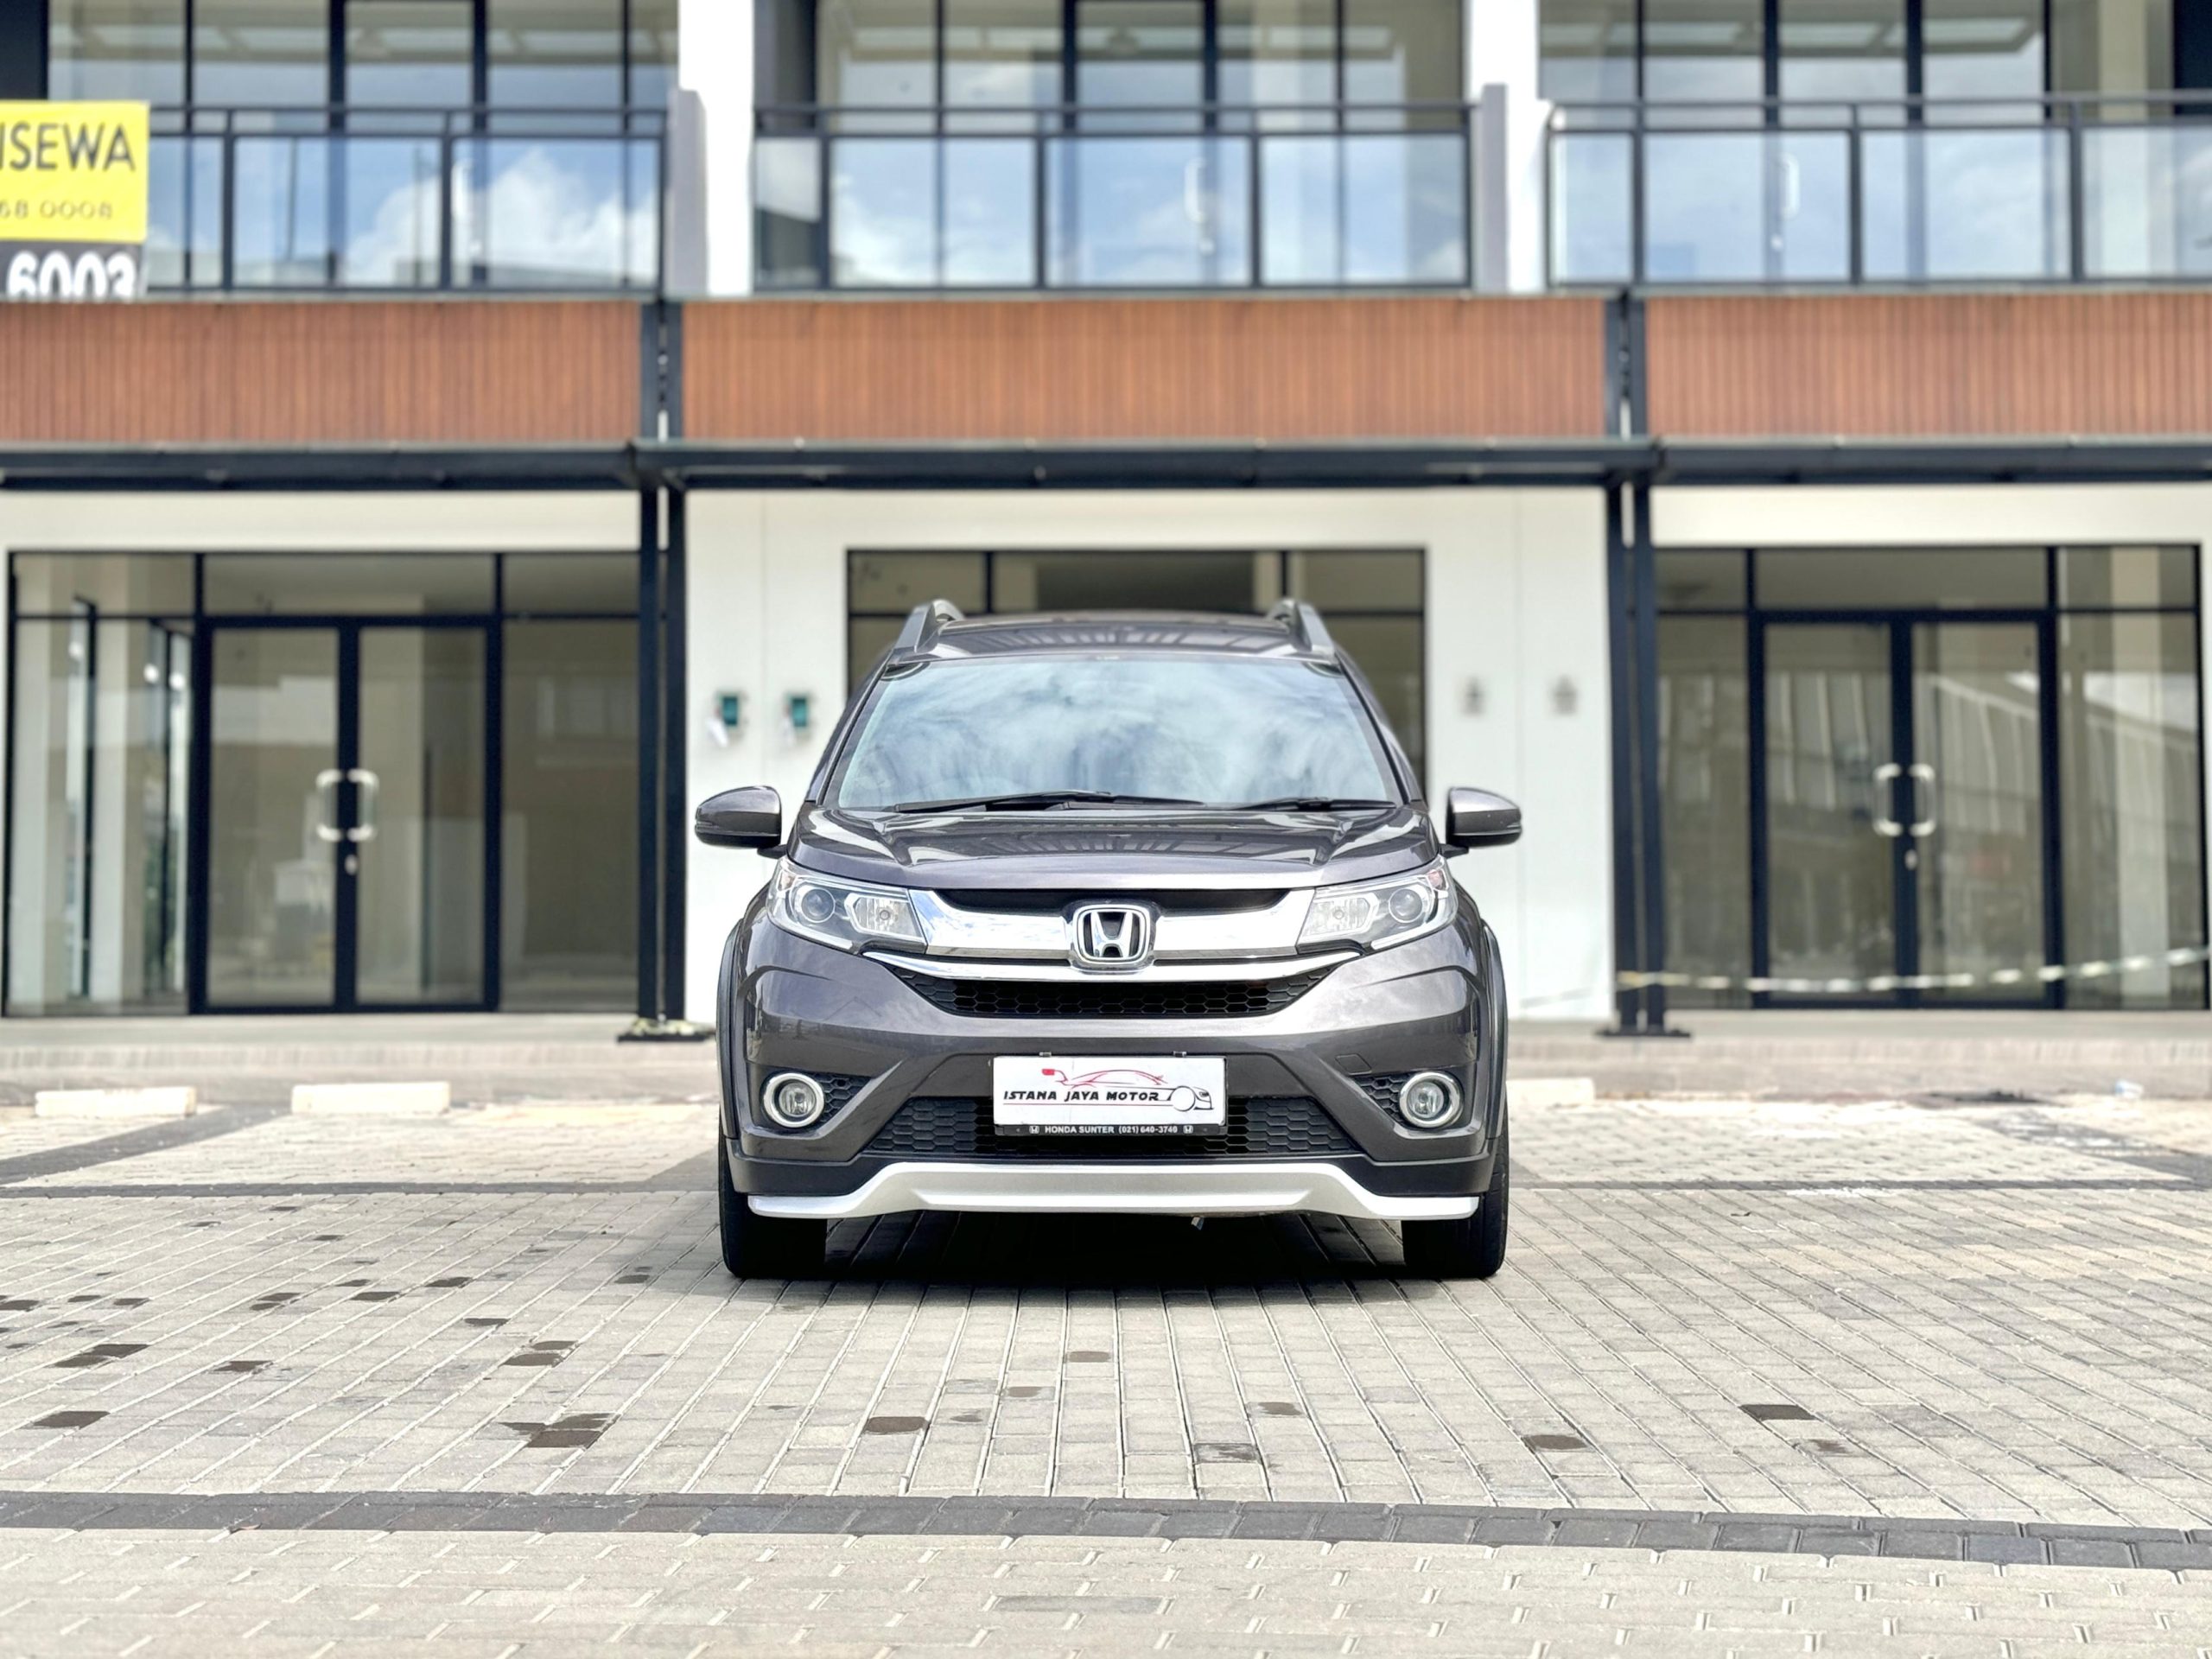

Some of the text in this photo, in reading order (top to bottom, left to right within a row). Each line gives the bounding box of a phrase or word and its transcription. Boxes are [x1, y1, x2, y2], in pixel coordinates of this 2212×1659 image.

[1003, 1090, 1160, 1103] ISTANA JAYA MOTOR
[1045, 1125, 1077, 1134] HONDA
[1078, 1125, 1115, 1134] SUNTER
[1118, 1125, 1139, 1135] (021)
